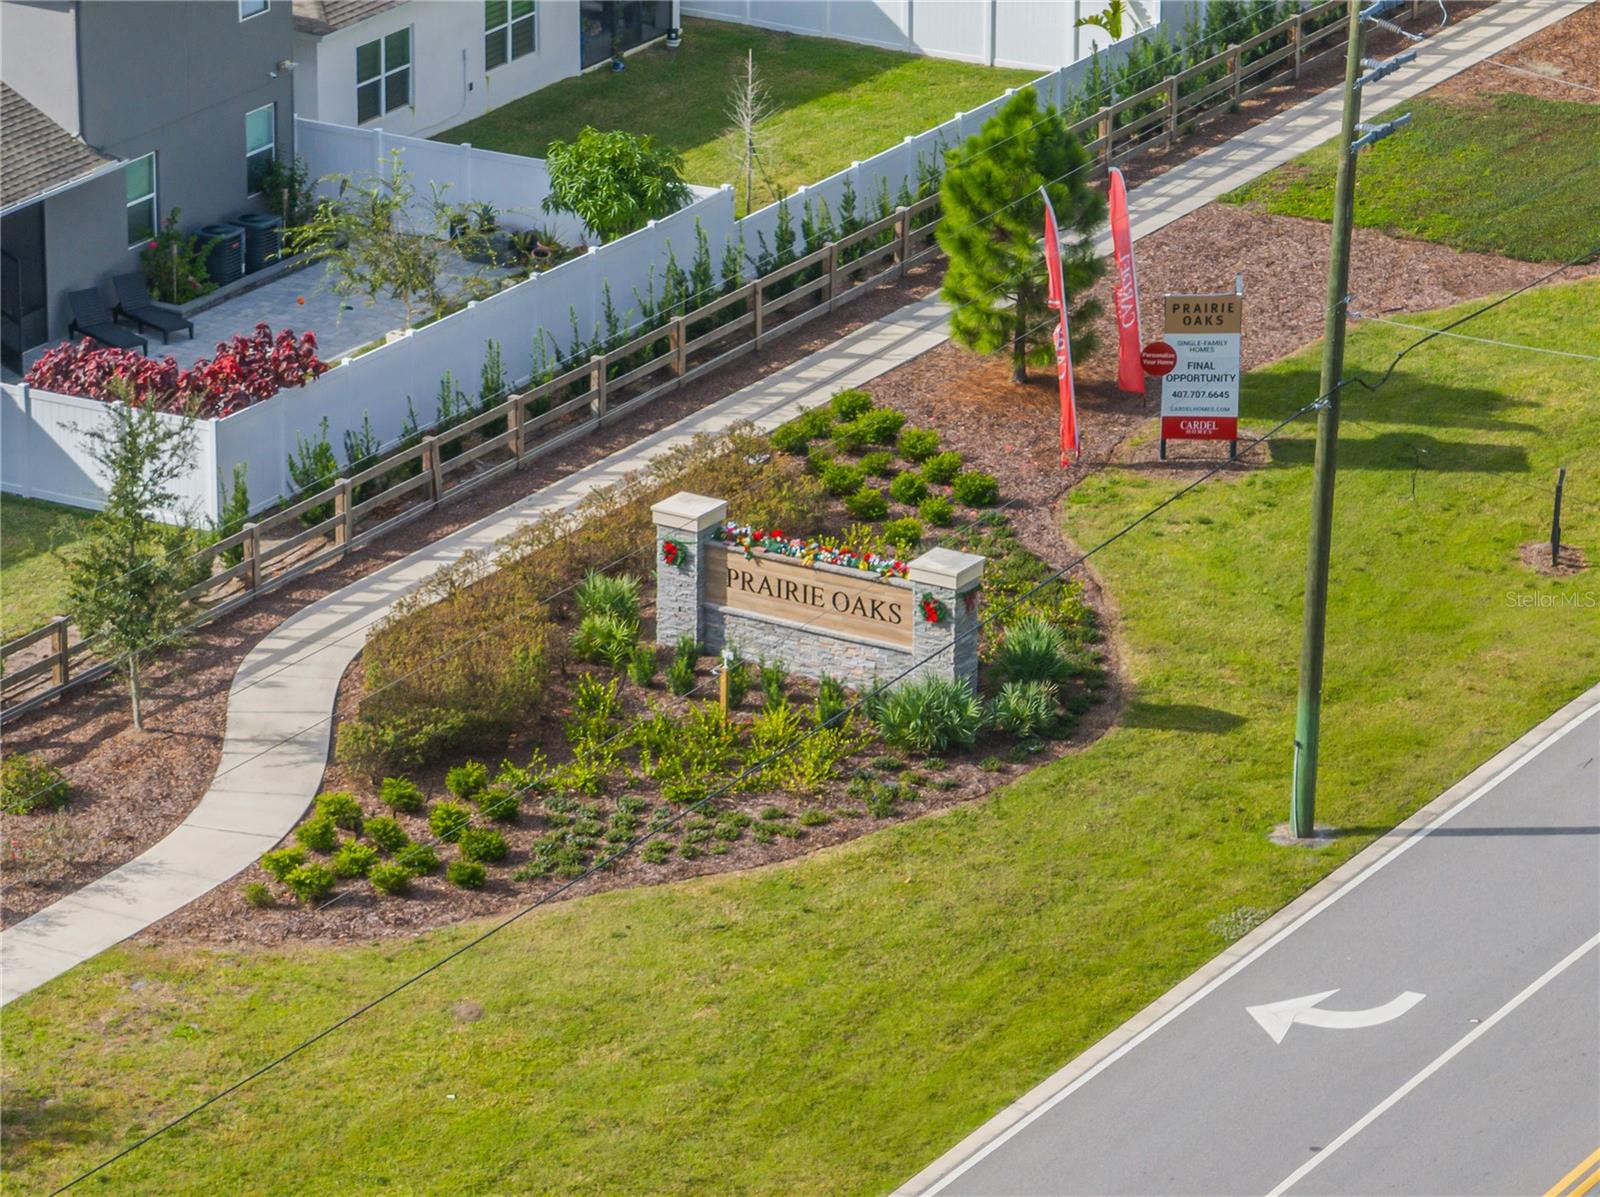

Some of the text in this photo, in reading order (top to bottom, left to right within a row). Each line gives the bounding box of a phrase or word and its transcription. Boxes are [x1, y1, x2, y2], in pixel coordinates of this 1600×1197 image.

[1172, 303, 1235, 313] PRAIRIE
[1183, 315, 1224, 326] OAKS
[1187, 361, 1215, 370] FINAL
[1166, 374, 1236, 383] OPPORTUNITY
[1171, 390, 1230, 399] 407.707.6645
[1180, 420, 1219, 431] CARDEL
[727, 567, 902, 625] PRAIRIE OAKS
